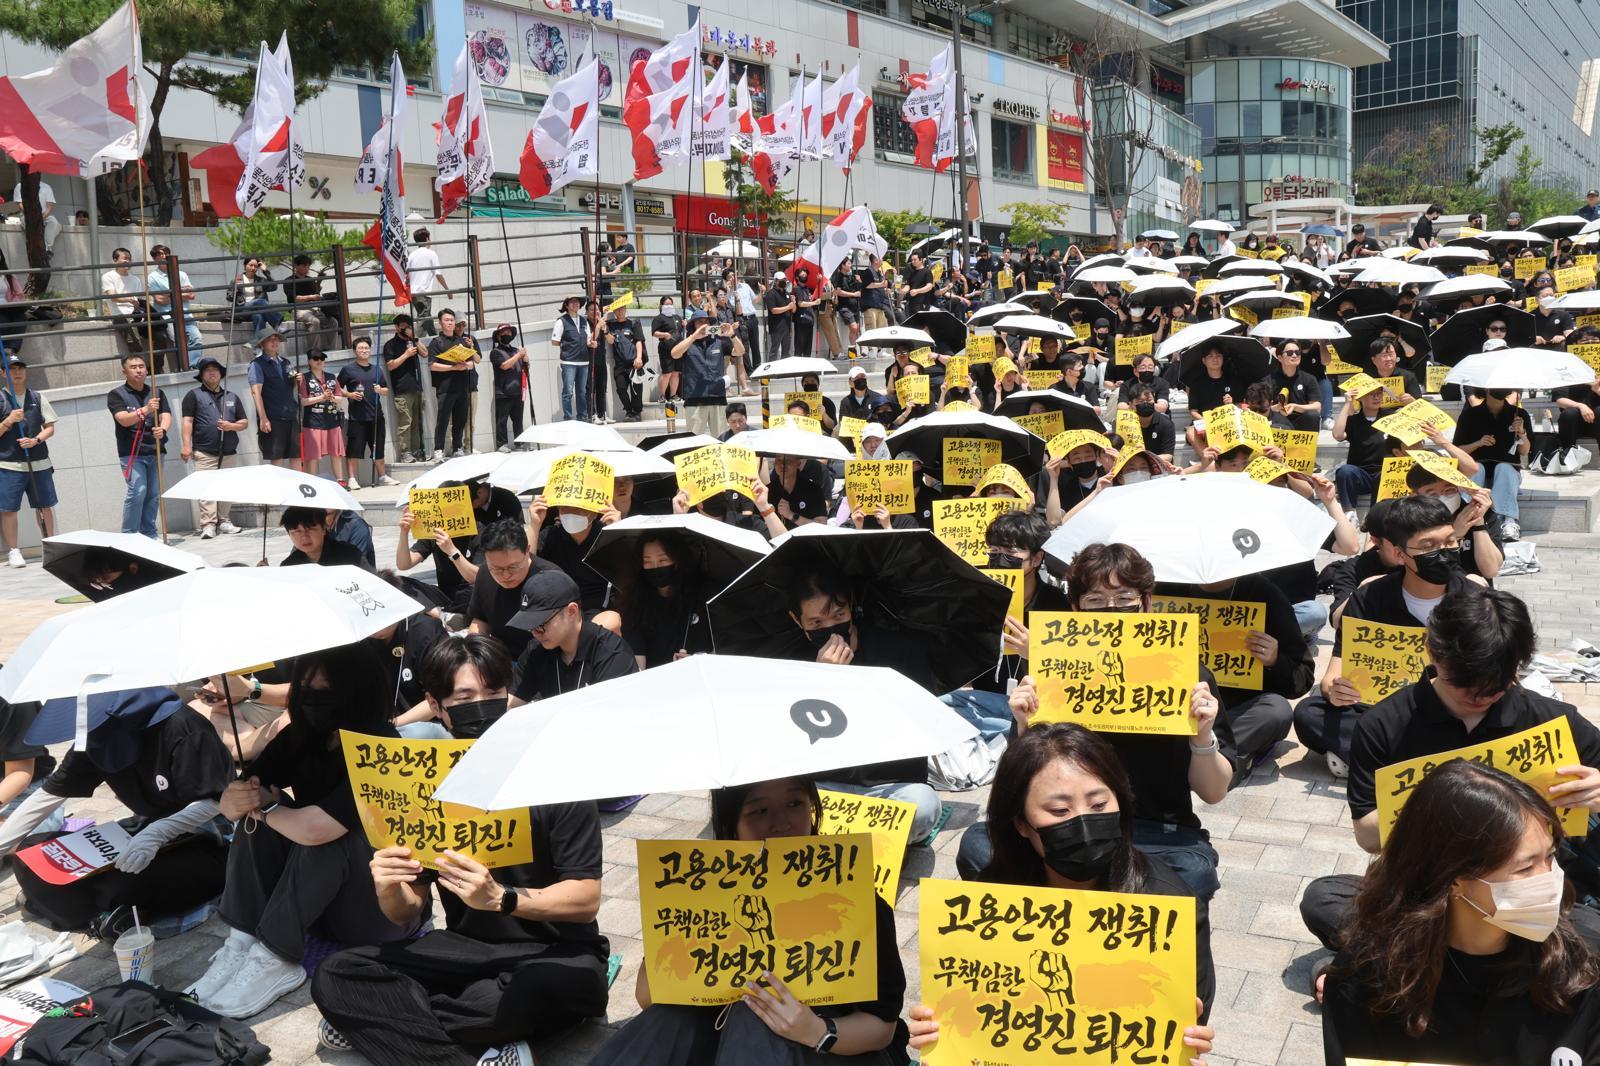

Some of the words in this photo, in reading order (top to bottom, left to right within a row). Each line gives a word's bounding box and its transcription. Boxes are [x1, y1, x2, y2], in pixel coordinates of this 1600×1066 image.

[487, 185, 530, 202] Salady
[947, 441, 981, 453] 고용안정
[1291, 434, 1314, 446] 쟁취!
[681, 446, 721, 470] 고용안정
[848, 462, 881, 478] 고용안정
[884, 462, 908, 477] 쟁취!
[412, 490, 440, 505] 고용안정
[442, 489, 465, 502] 쟁취!
[554, 484, 585, 500] 경영진
[884, 492, 908, 508] 퇴진!
[940, 501, 987, 520] 고용안정
[446, 516, 470, 532] 퇴진!
[1215, 603, 1258, 628] 쟁취!
[1040, 617, 1124, 648] 고용안정
[1132, 620, 1189, 649] 쟁취!
[1352, 625, 1427, 651] 고용안정
[1037, 658, 1095, 681] 무책임한
[1213, 653, 1255, 677] 퇴진!
[1348, 652, 1400, 675] 무책임한
[1063, 684, 1126, 715] 경영진
[1129, 685, 1188, 718] 퇴진!
[355, 743, 438, 779] 고용안정
[1506, 728, 1564, 775] 쟁취!
[359, 782, 411, 814] 무책임한
[864, 801, 907, 832] 쟁취!
[385, 815, 449, 853] 경영진
[452, 818, 518, 856] 퇴진!
[654, 848, 770, 891] 고용안정
[782, 843, 859, 888] 쟁취!
[653, 907, 732, 940] 무책임한
[938, 892, 1073, 947] 고용안정
[1087, 902, 1179, 955] 쟁취!
[689, 940, 777, 989] 경영진
[783, 939, 862, 988] 퇴진!
[933, 956, 1026, 997] 무책임한
[976, 999, 1078, 1055] 경영진
[1083, 1010, 1178, 1065] 퇴진!
